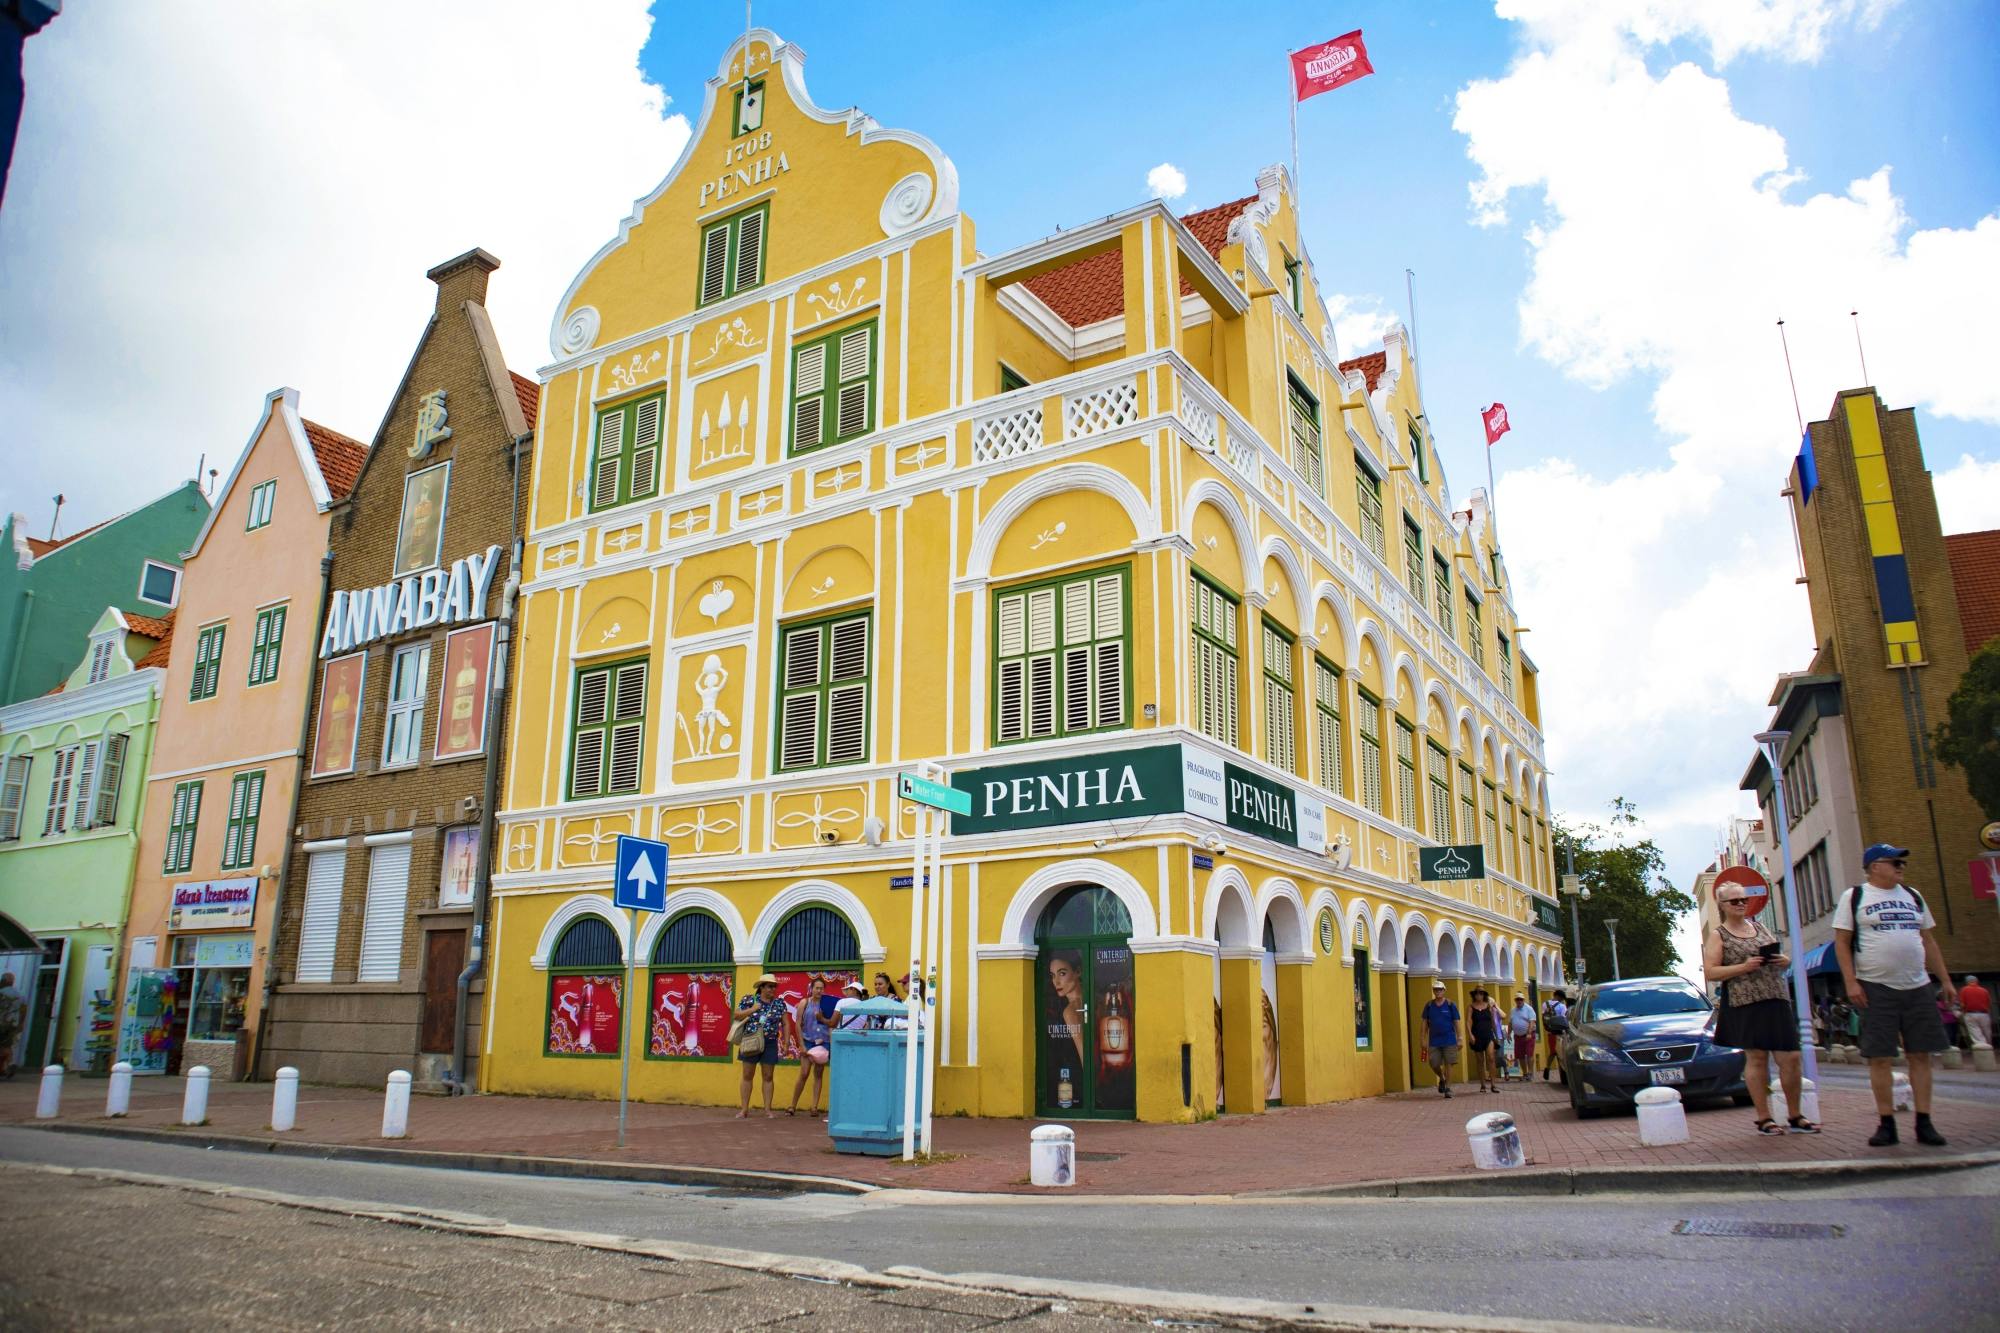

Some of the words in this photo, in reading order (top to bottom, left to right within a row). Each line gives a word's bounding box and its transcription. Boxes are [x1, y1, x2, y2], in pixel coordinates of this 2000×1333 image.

[1310, 48, 1350, 74] ANNABAY
[725, 131, 773, 167] 1708
[698, 151, 791, 208] PENHA
[318, 544, 504, 660] ANNABAY
[1186, 760, 1222, 782] FRAGRANCES
[982, 764, 1147, 817] PENHA
[1188, 788, 1219, 807] COSMETICS
[1229, 777, 1294, 833] PENHA
[1439, 866, 1467, 875] PENHA
[175, 887, 202, 906] Island
[204, 883, 250, 904] Treasures
[1871, 923, 1896, 931] WEST
[1096, 949, 1129, 960] L'INTERDIT
[1047, 1024, 1081, 1034] L'INTERDIT
